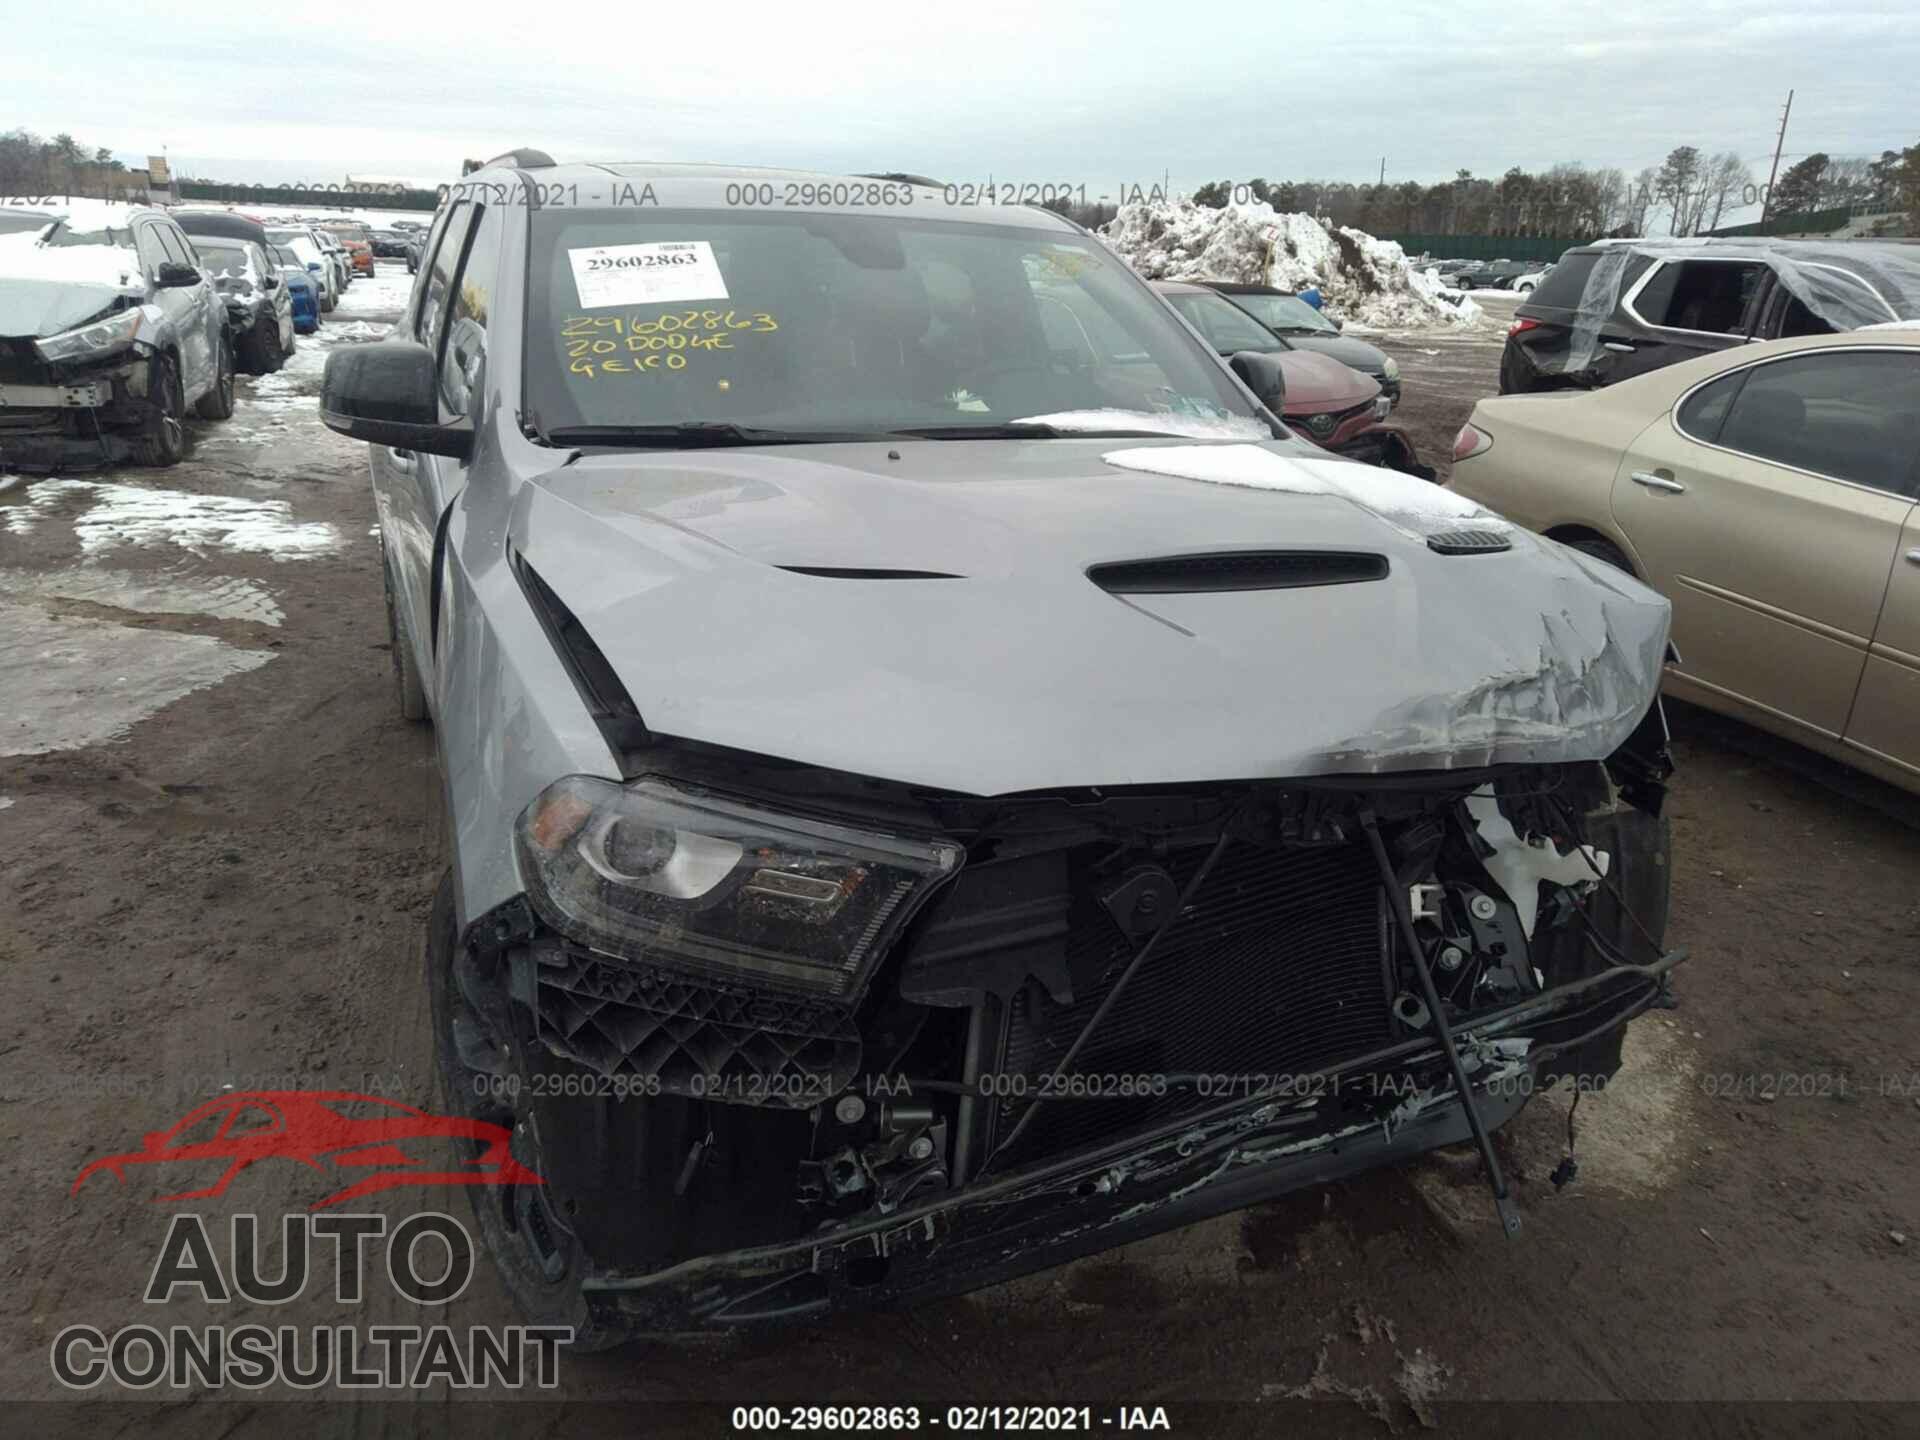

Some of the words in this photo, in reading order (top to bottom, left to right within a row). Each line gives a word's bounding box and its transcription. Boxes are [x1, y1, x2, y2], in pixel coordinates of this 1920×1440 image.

[586, 253, 698, 270] 29602863
[561, 311, 778, 336] 29602863
[565, 339, 617, 357] 20
[625, 333, 735, 351] DODGE
[570, 353, 687, 378] GEICO
